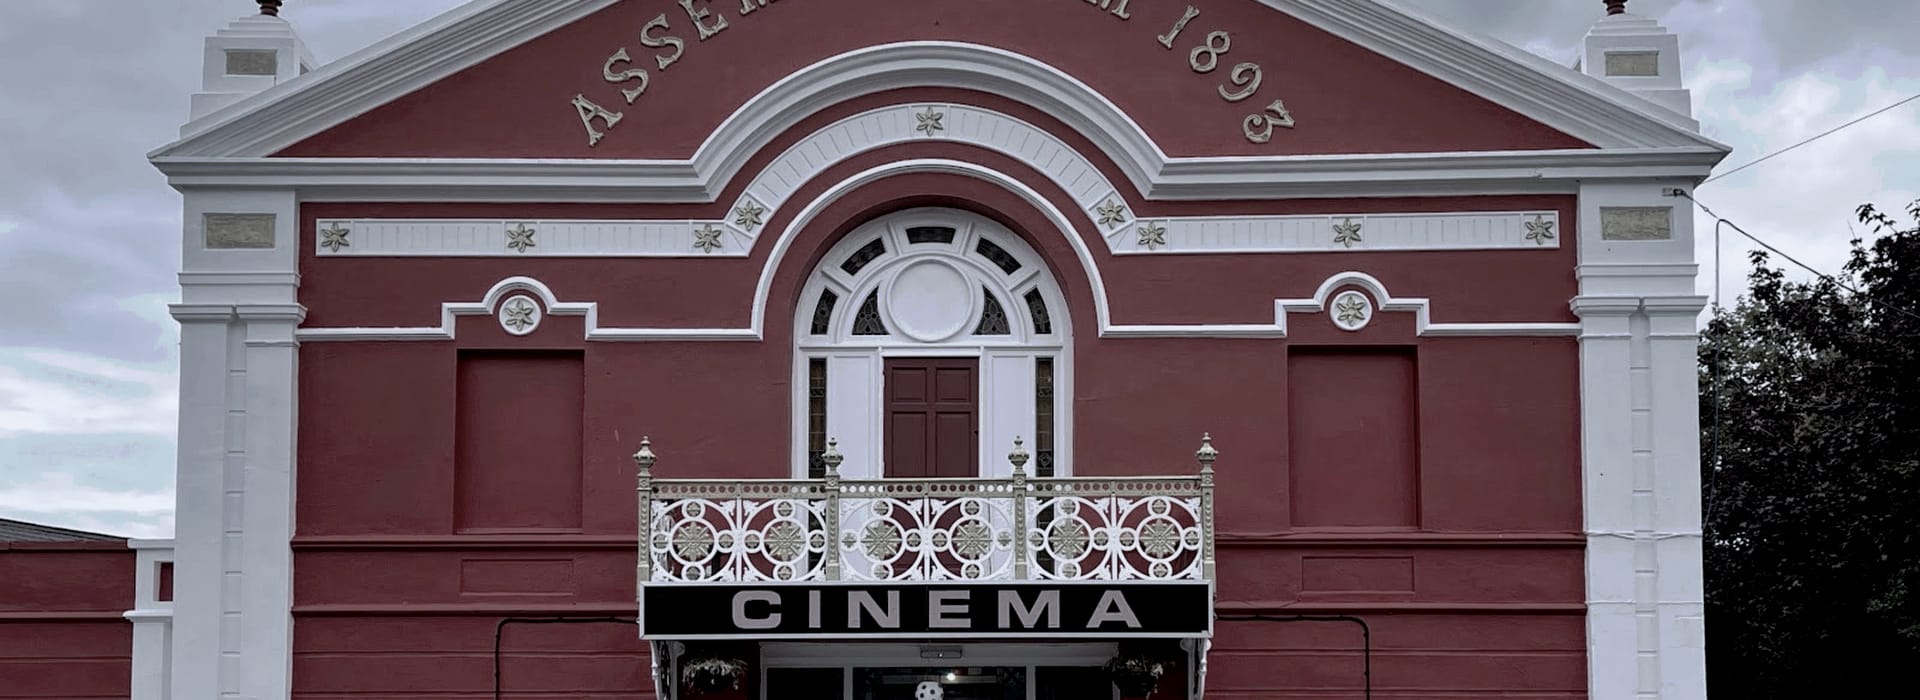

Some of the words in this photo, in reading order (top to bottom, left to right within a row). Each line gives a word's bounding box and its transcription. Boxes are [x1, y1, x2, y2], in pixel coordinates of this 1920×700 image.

[571, 0, 776, 146] ASSE
[1157, 5, 1295, 143] 1893
[731, 589, 1142, 629] CINEMA
